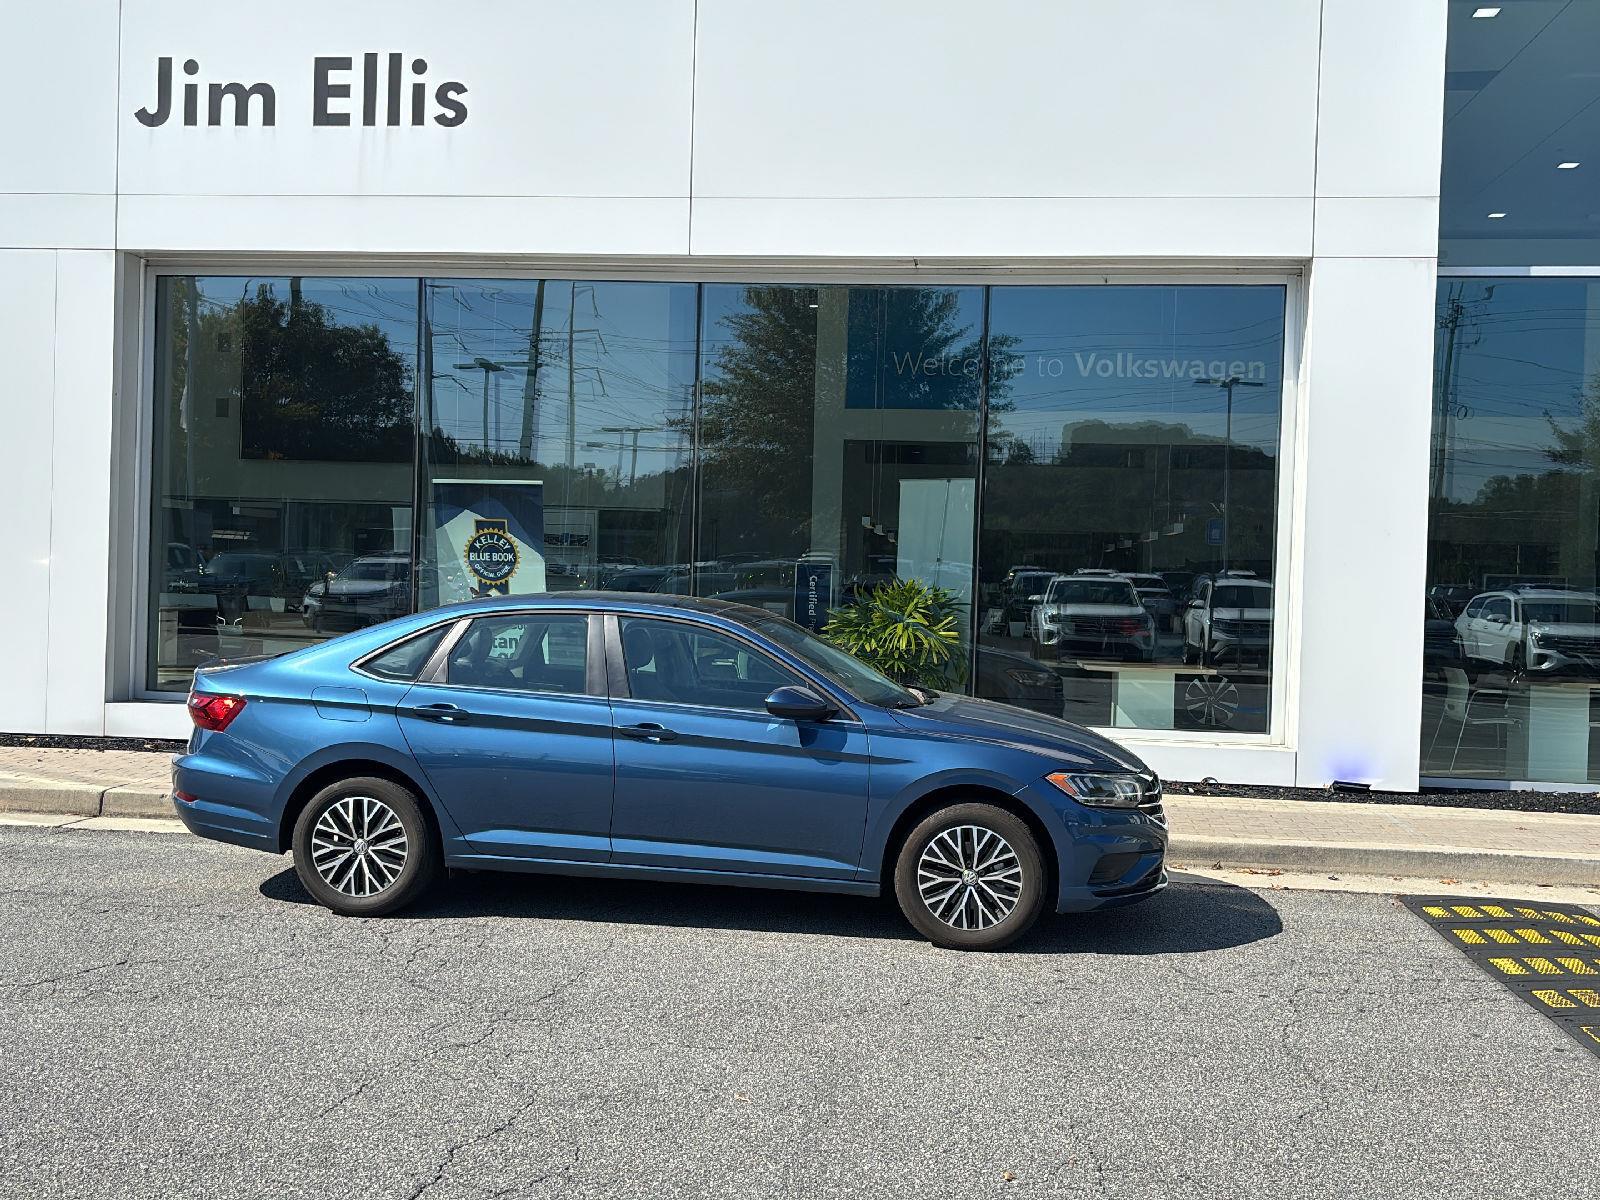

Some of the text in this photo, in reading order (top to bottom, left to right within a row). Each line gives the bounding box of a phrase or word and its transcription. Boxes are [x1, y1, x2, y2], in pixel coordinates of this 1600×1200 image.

[134, 53, 468, 127] Jim Ellis
[1037, 355, 1064, 376] to
[474, 535, 511, 550] KELLEY
[469, 552, 515, 562] BLUE BOOK
[808, 575, 818, 615] Certified
